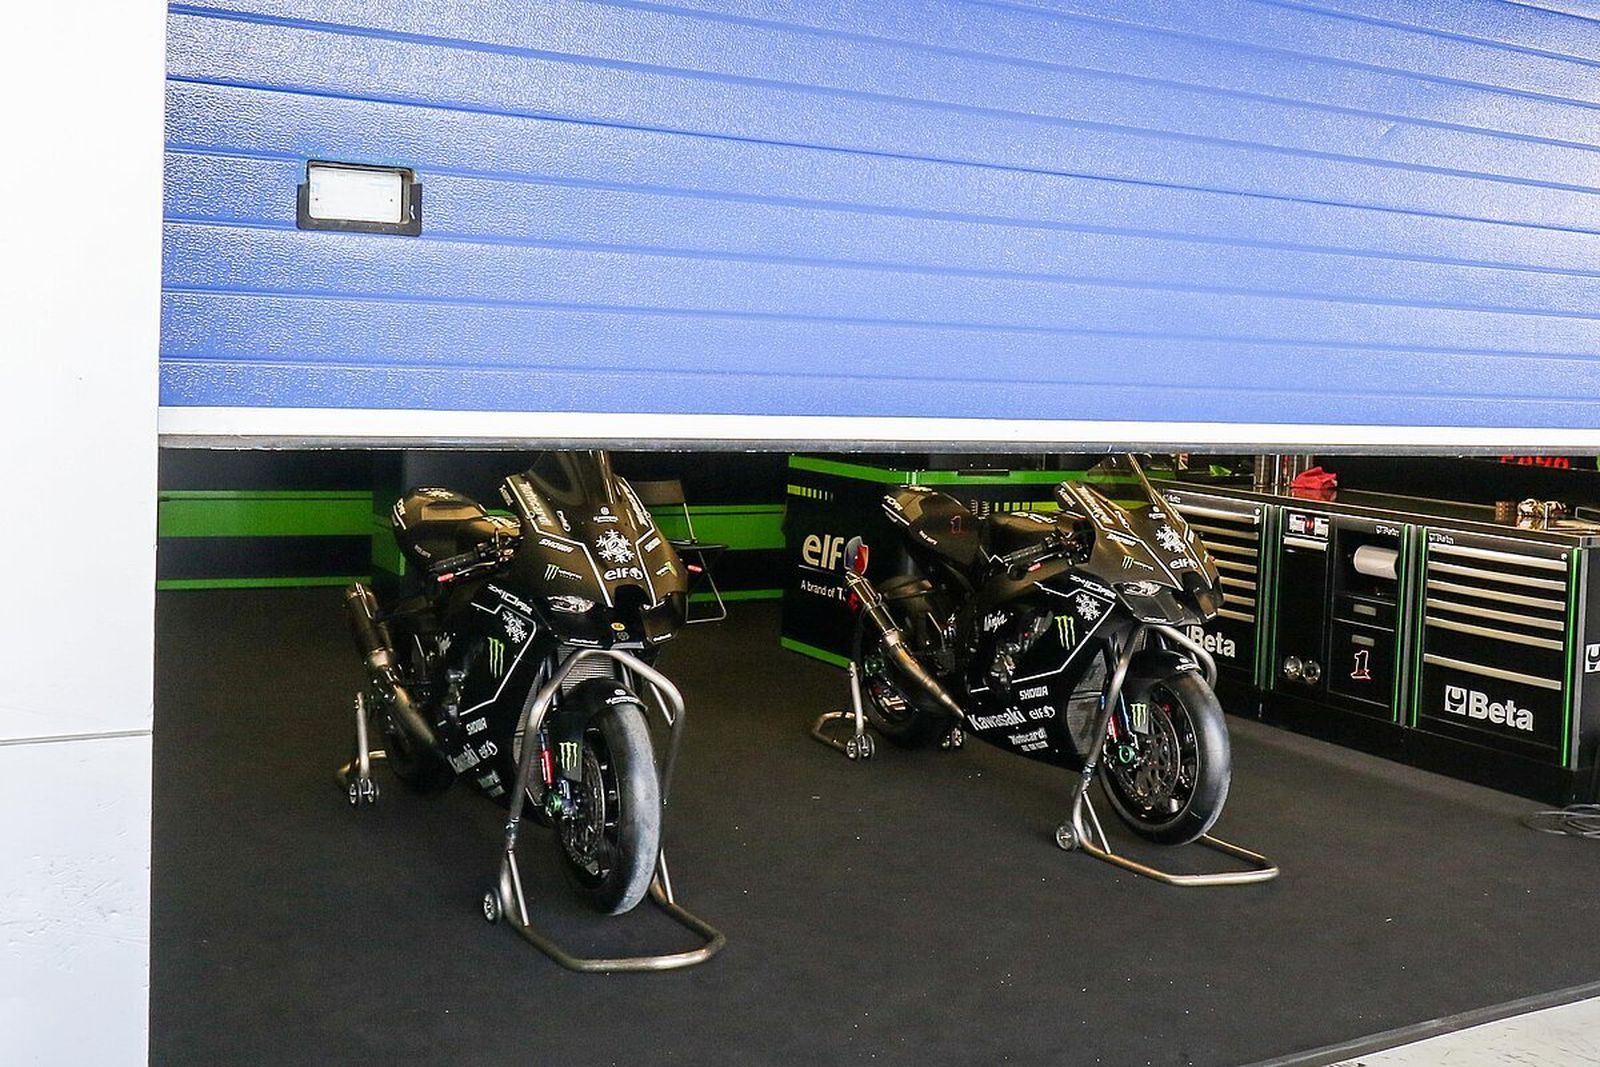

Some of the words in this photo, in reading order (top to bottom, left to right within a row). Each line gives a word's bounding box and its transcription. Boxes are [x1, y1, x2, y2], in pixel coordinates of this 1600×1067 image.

[802, 534, 845, 570] elf
[800, 579, 806, 591] A
[807, 581, 827, 596] brand
[827, 587, 836, 598] of
[1190, 625, 1236, 658] Beta
[1350, 649, 1373, 680] 1
[1019, 685, 1049, 701] SHOWA
[967, 706, 1027, 731] Kawasaki
[1468, 690, 1534, 732] Beta
